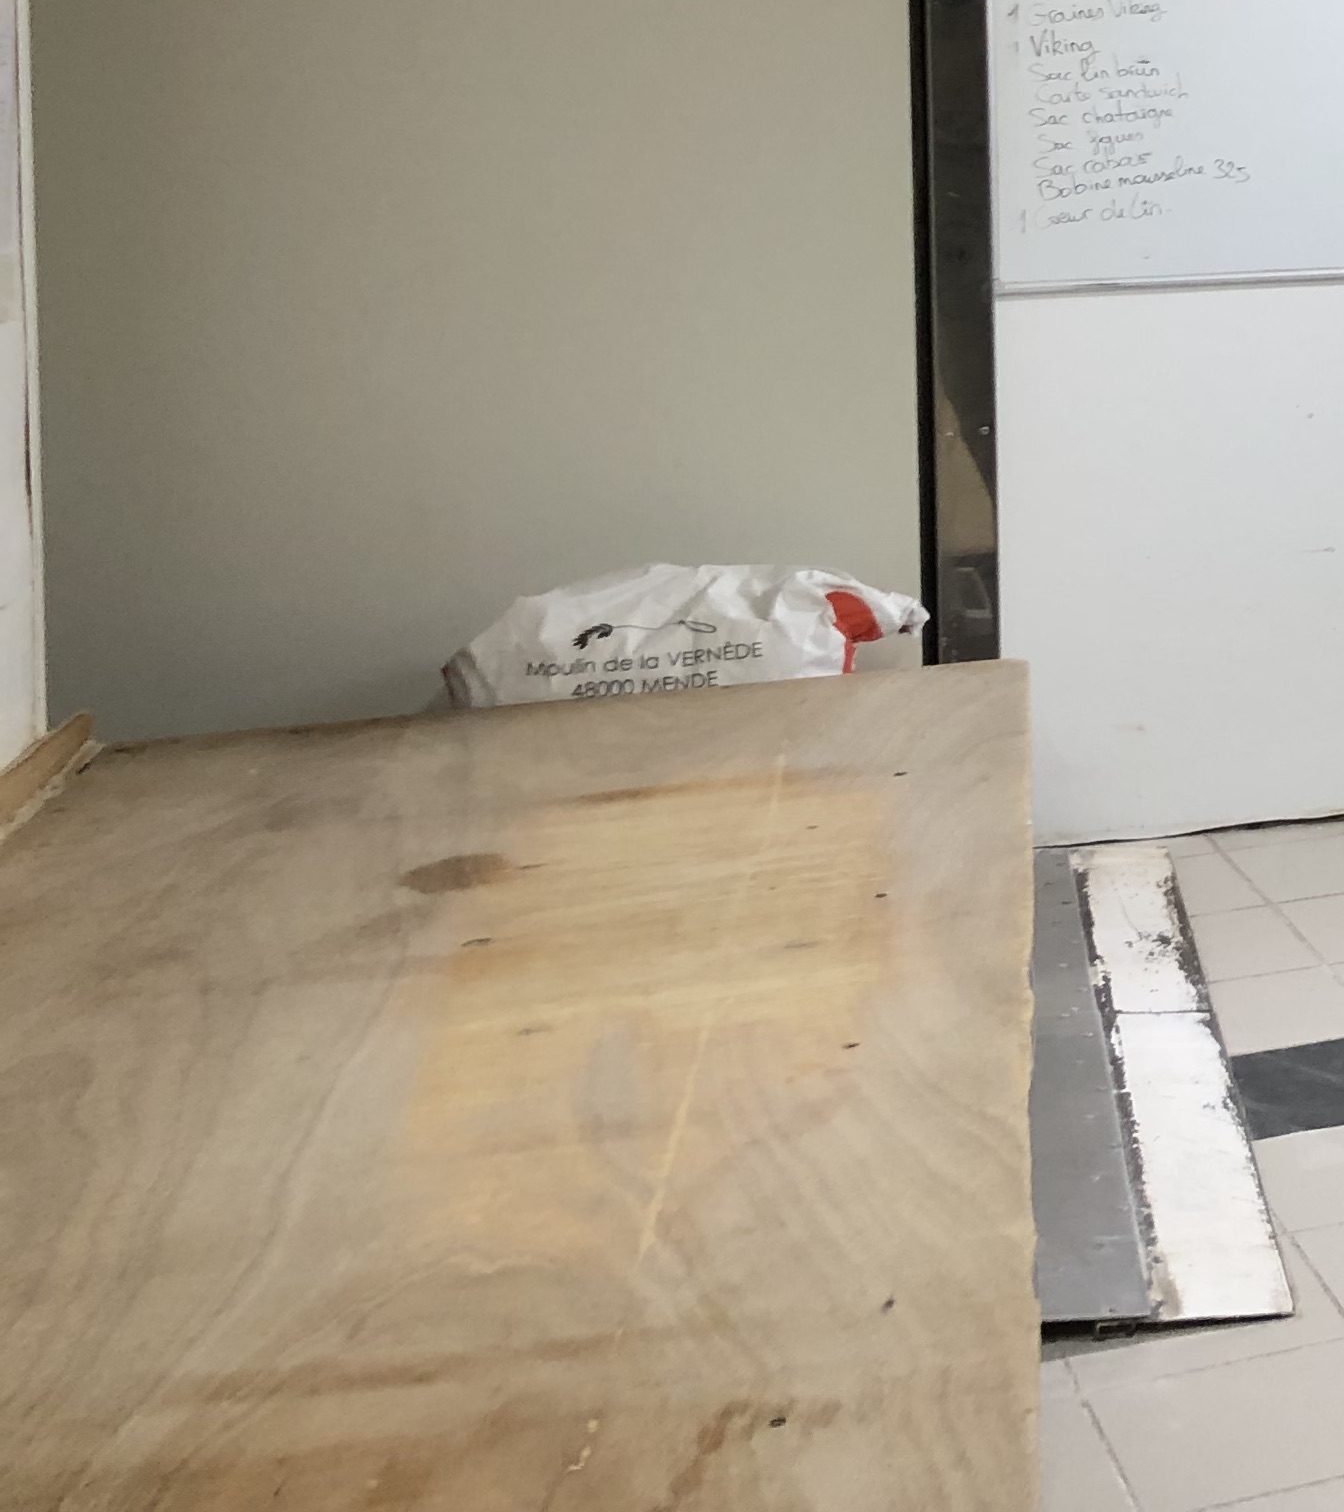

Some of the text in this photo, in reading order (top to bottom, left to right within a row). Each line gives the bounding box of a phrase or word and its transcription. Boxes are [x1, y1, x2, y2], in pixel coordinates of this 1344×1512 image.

[526, 657, 597, 678] Moulin
[603, 656, 633, 674] de
[637, 654, 660, 670] la
